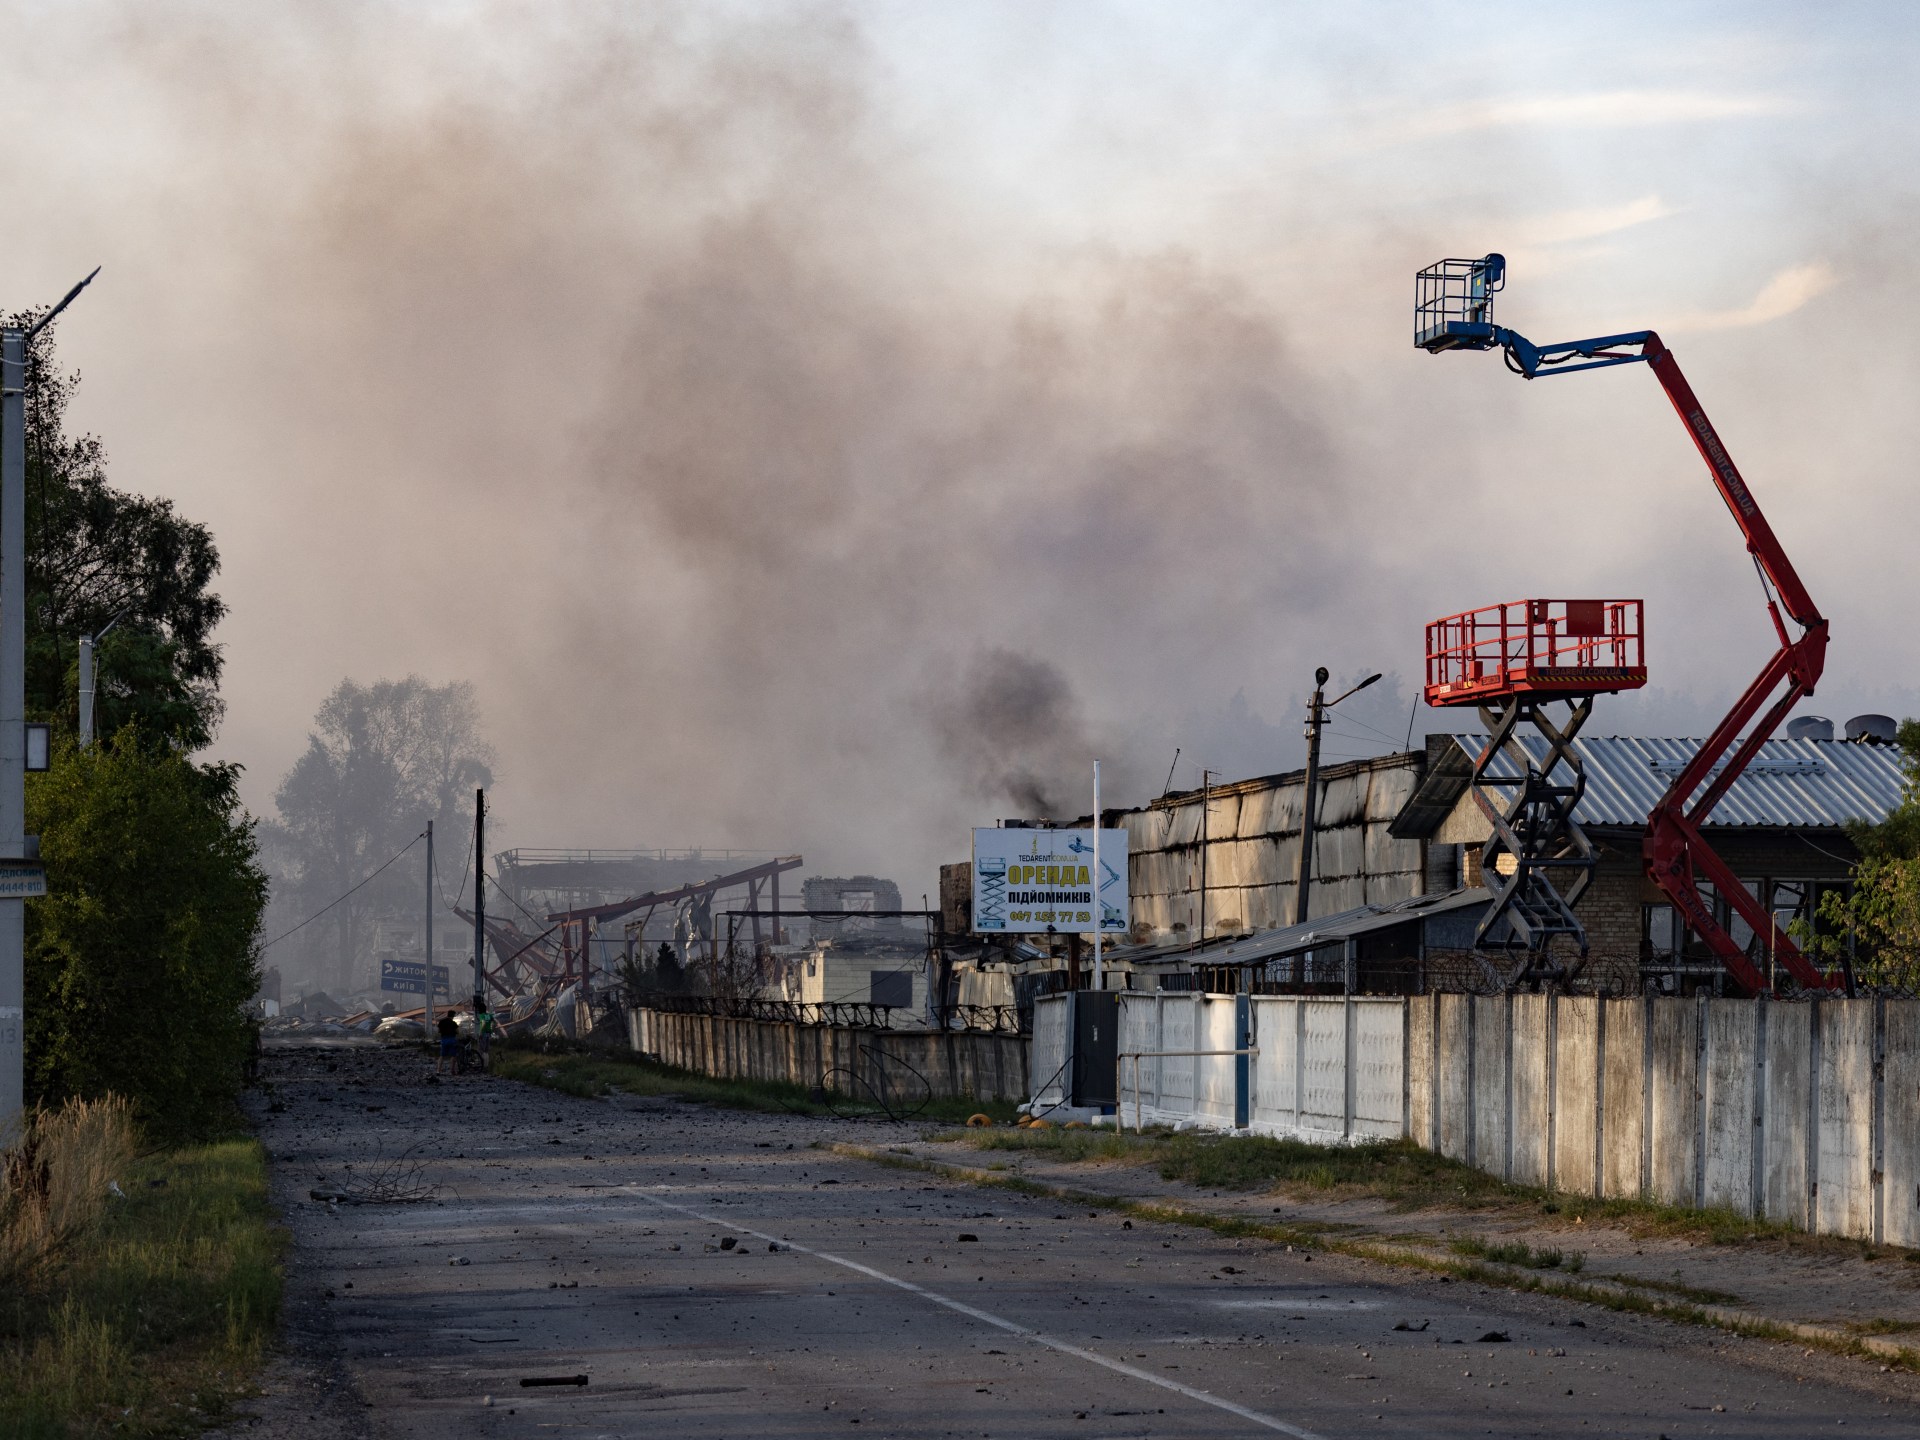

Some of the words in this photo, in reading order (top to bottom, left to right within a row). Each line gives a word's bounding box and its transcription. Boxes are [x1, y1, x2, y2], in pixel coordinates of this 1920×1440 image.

[1689, 409, 1756, 517] TEDARENT.COM.UA
[1544, 667, 1622, 676] TEDARENT.COM.UA
[1008, 865, 1090, 887] ОРЕНДА
[1008, 890, 1091, 904] ПІДЙОМНИКІВ
[1010, 911, 1031, 924] 067
[1034, 911, 1057, 923] 155
[1058, 911, 1074, 923] 77
[1076, 911, 1091, 923] 53
[394, 966, 437, 977] ЖИТОМР
[393, 981, 415, 991] КИЇВ
